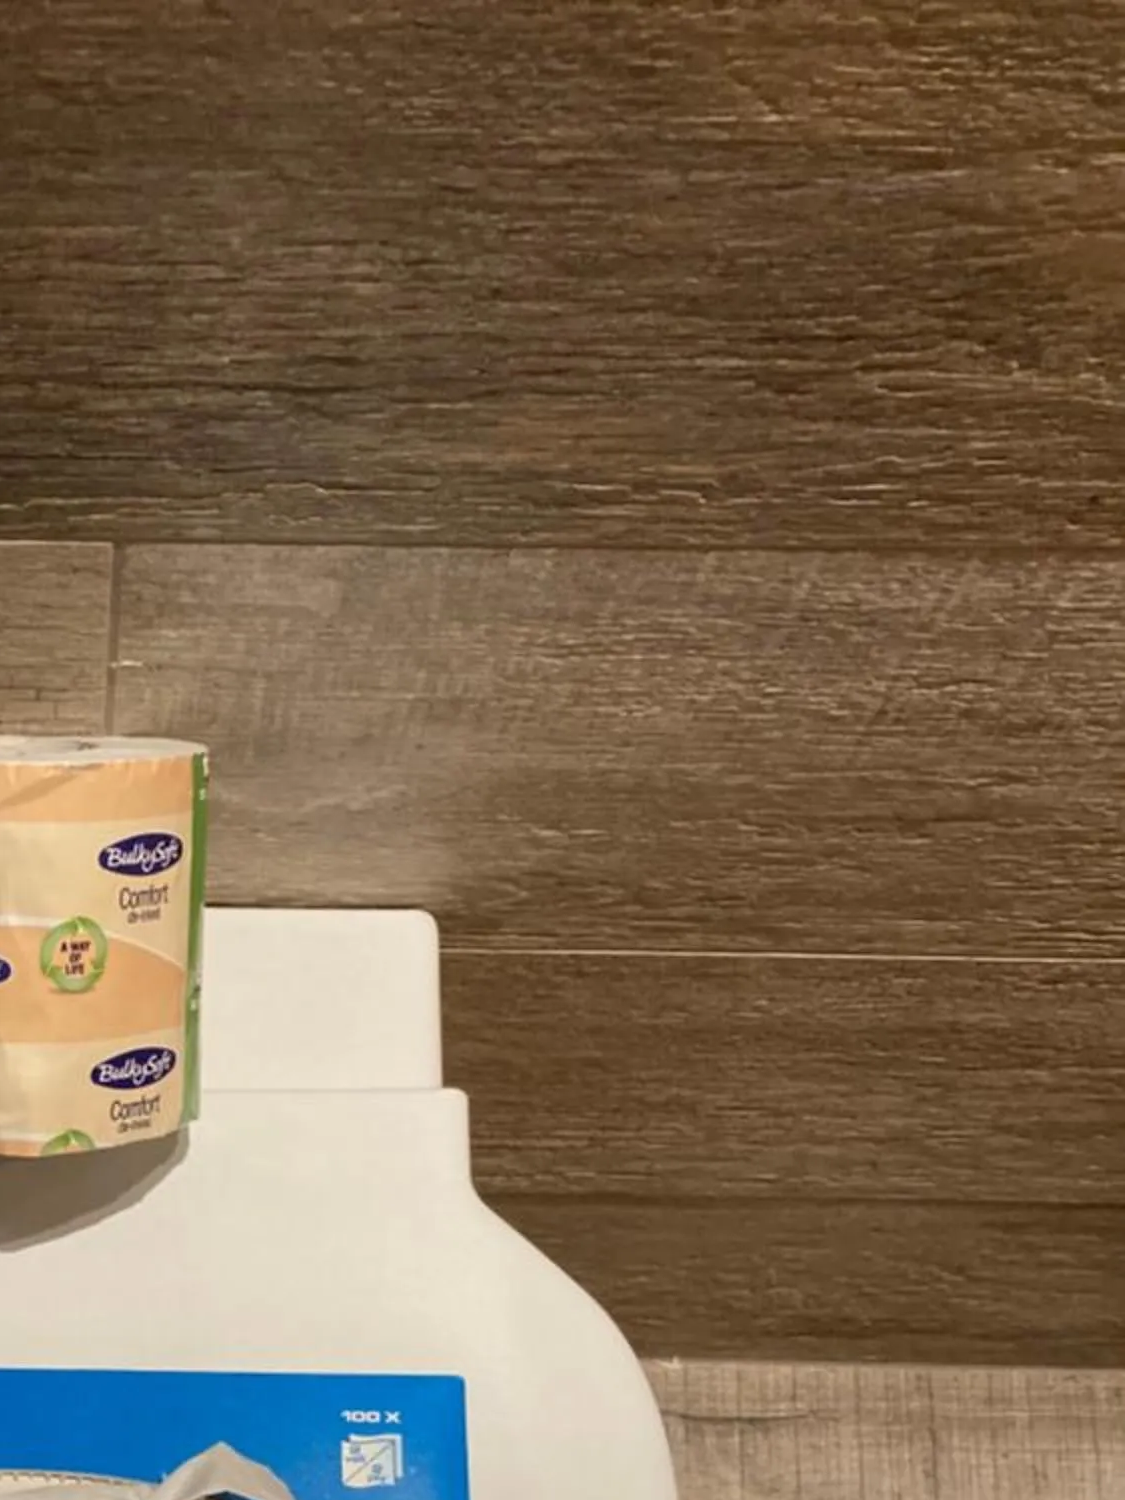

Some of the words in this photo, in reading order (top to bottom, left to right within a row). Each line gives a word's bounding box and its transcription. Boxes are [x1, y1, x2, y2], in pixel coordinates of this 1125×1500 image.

[106, 839, 178, 872] BulkySoft
[119, 884, 168, 910] Comfort
[99, 1051, 171, 1085] BulkySoft
[110, 1095, 160, 1121] Comfort
[340, 1410, 380, 1423] 100
